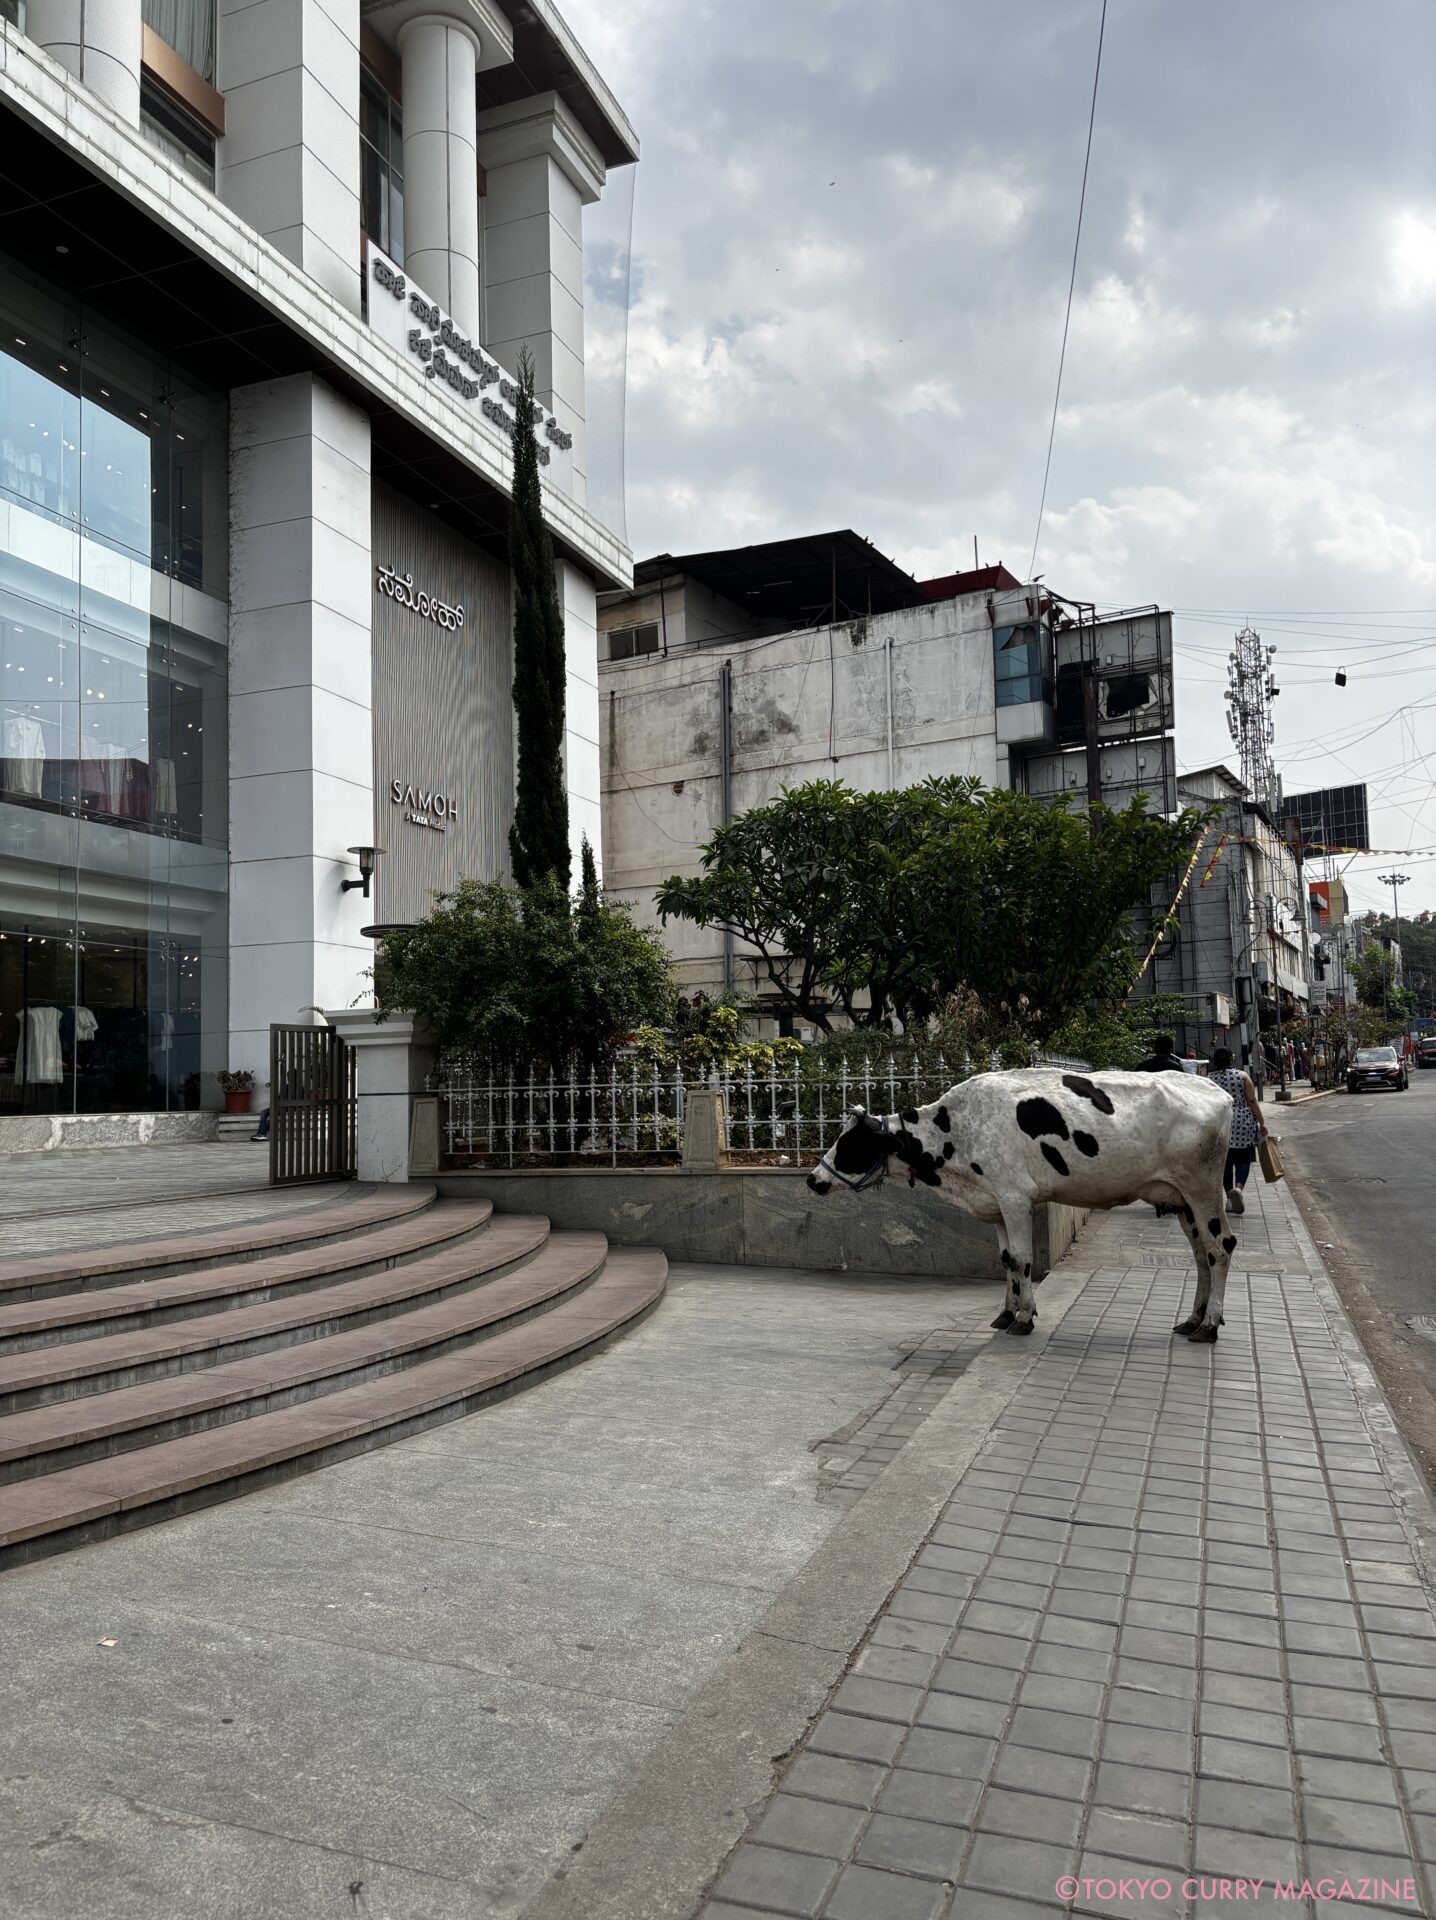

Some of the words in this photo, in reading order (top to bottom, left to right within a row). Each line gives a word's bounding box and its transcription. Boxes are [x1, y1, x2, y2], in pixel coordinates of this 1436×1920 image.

[377, 565, 465, 632] ಸಮೋಹ್
[392, 779, 458, 821] SAMOH
[411, 813, 429, 826] TATA
